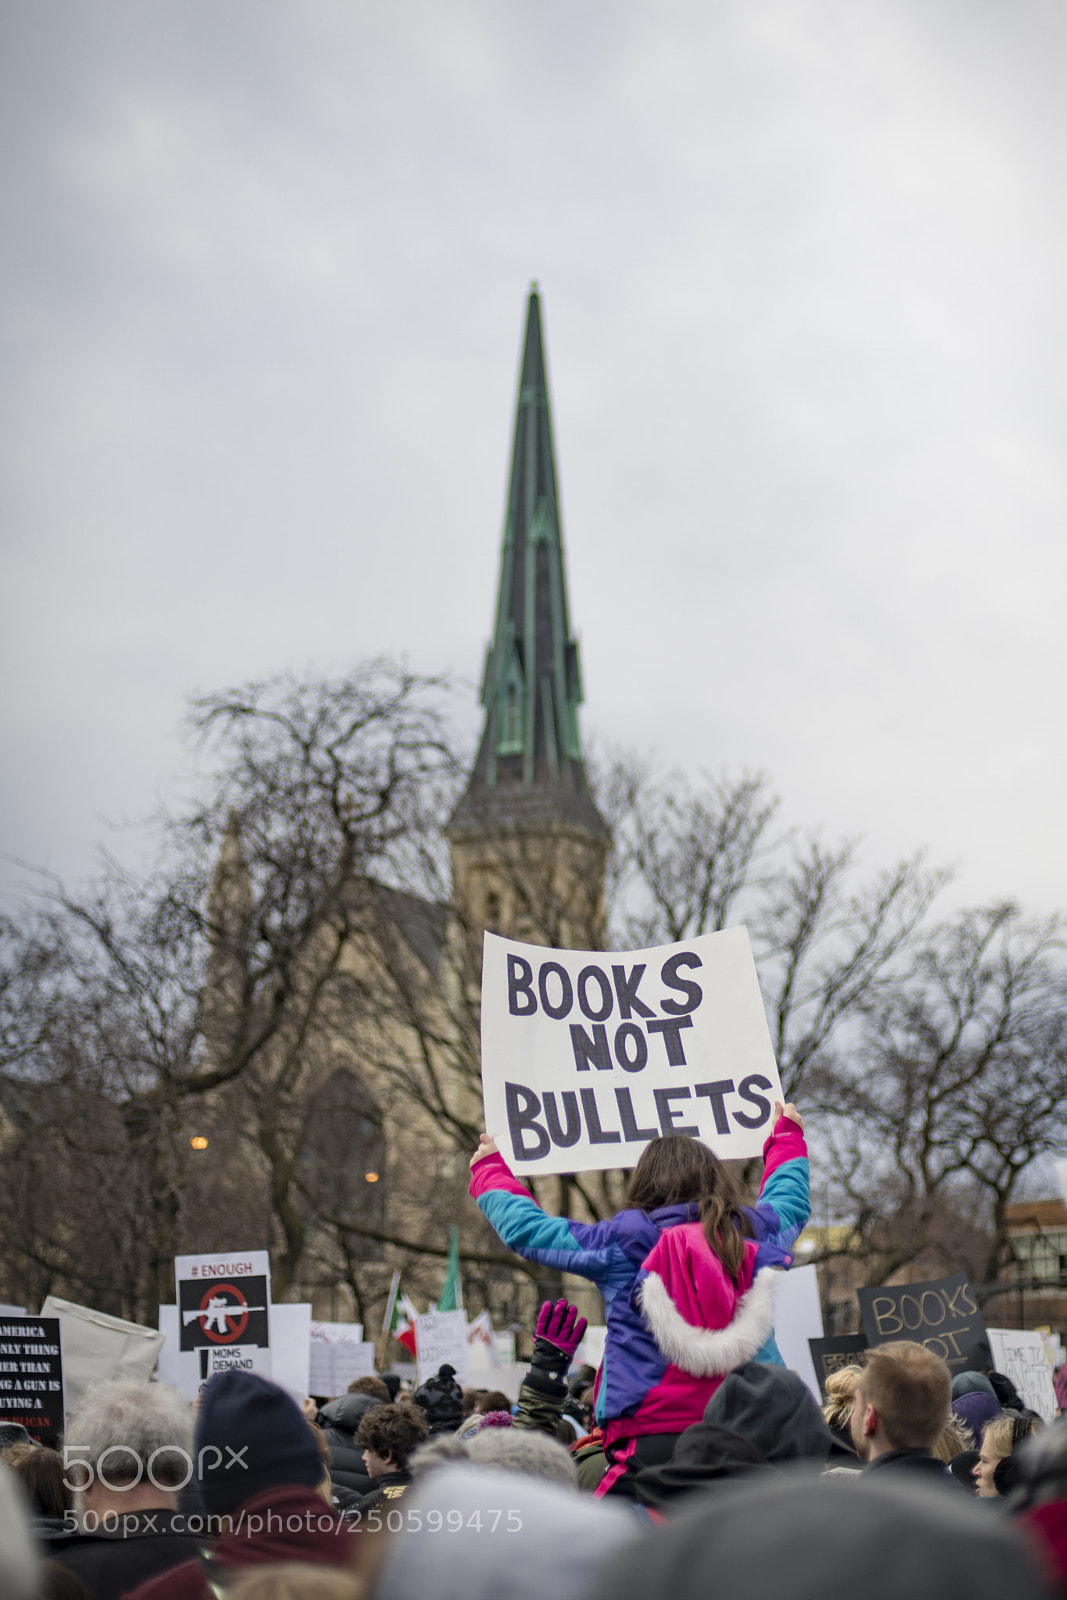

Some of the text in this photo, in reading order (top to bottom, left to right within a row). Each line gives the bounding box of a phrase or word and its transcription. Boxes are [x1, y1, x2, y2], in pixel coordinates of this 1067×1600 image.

[507, 952, 703, 1022] BOOKS
[569, 1015, 693, 1073] NOT
[505, 1074, 773, 1161] BULLETS
[872, 1283, 978, 1336] BOOKS
[23, 1344, 59, 1356] THING
[923, 1327, 970, 1361] OT
[213, 1348, 241, 1360] MOMS
[20, 1362, 51, 1374] THAN
[213, 1359, 253, 1371] DEMAND
[14, 1379, 23, 1391] A
[23, 1380, 47, 1392] GUN
[48, 1381, 61, 1392] IS
[33, 1398, 43, 1409] A
